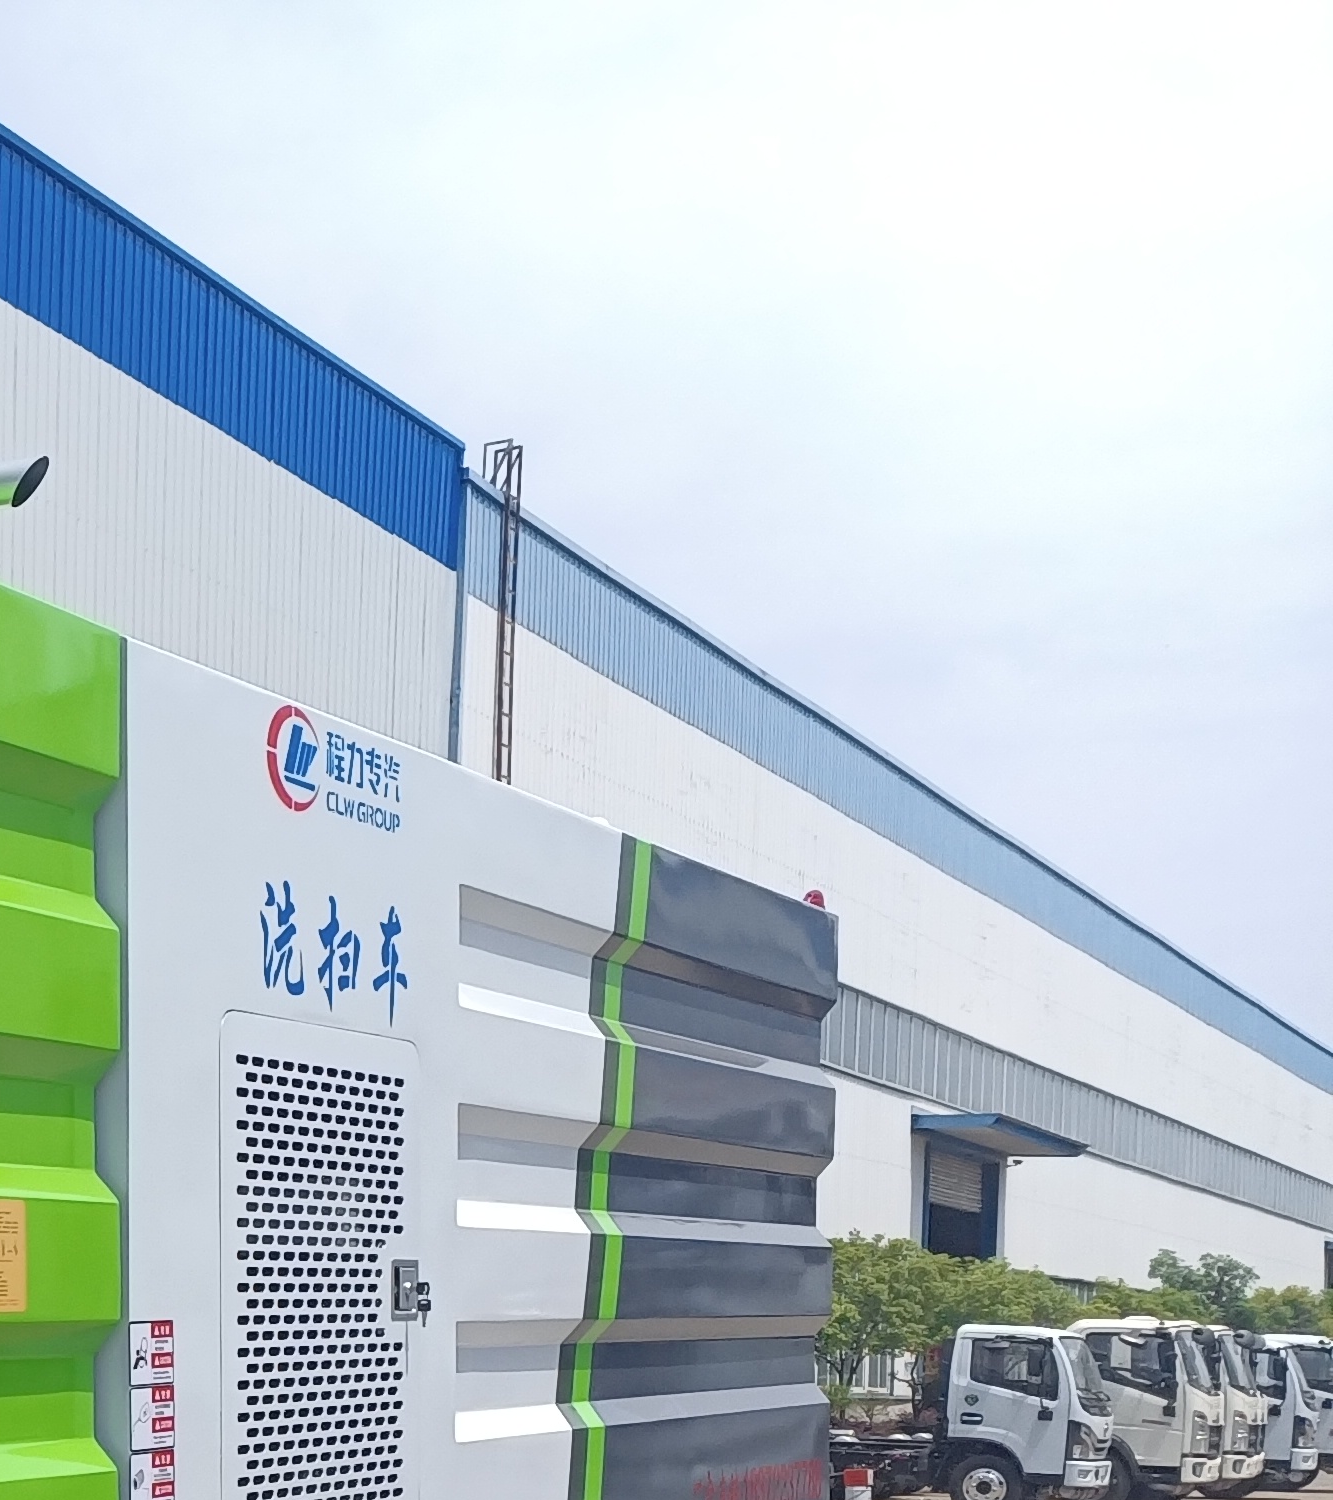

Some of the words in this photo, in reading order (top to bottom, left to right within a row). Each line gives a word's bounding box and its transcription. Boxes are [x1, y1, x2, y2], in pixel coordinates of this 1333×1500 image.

[326, 731, 401, 803] 程力专汽
[326, 791, 355, 819] CLW
[357, 801, 401, 834] GROUP
[259, 880, 408, 1028] 洗扫车
